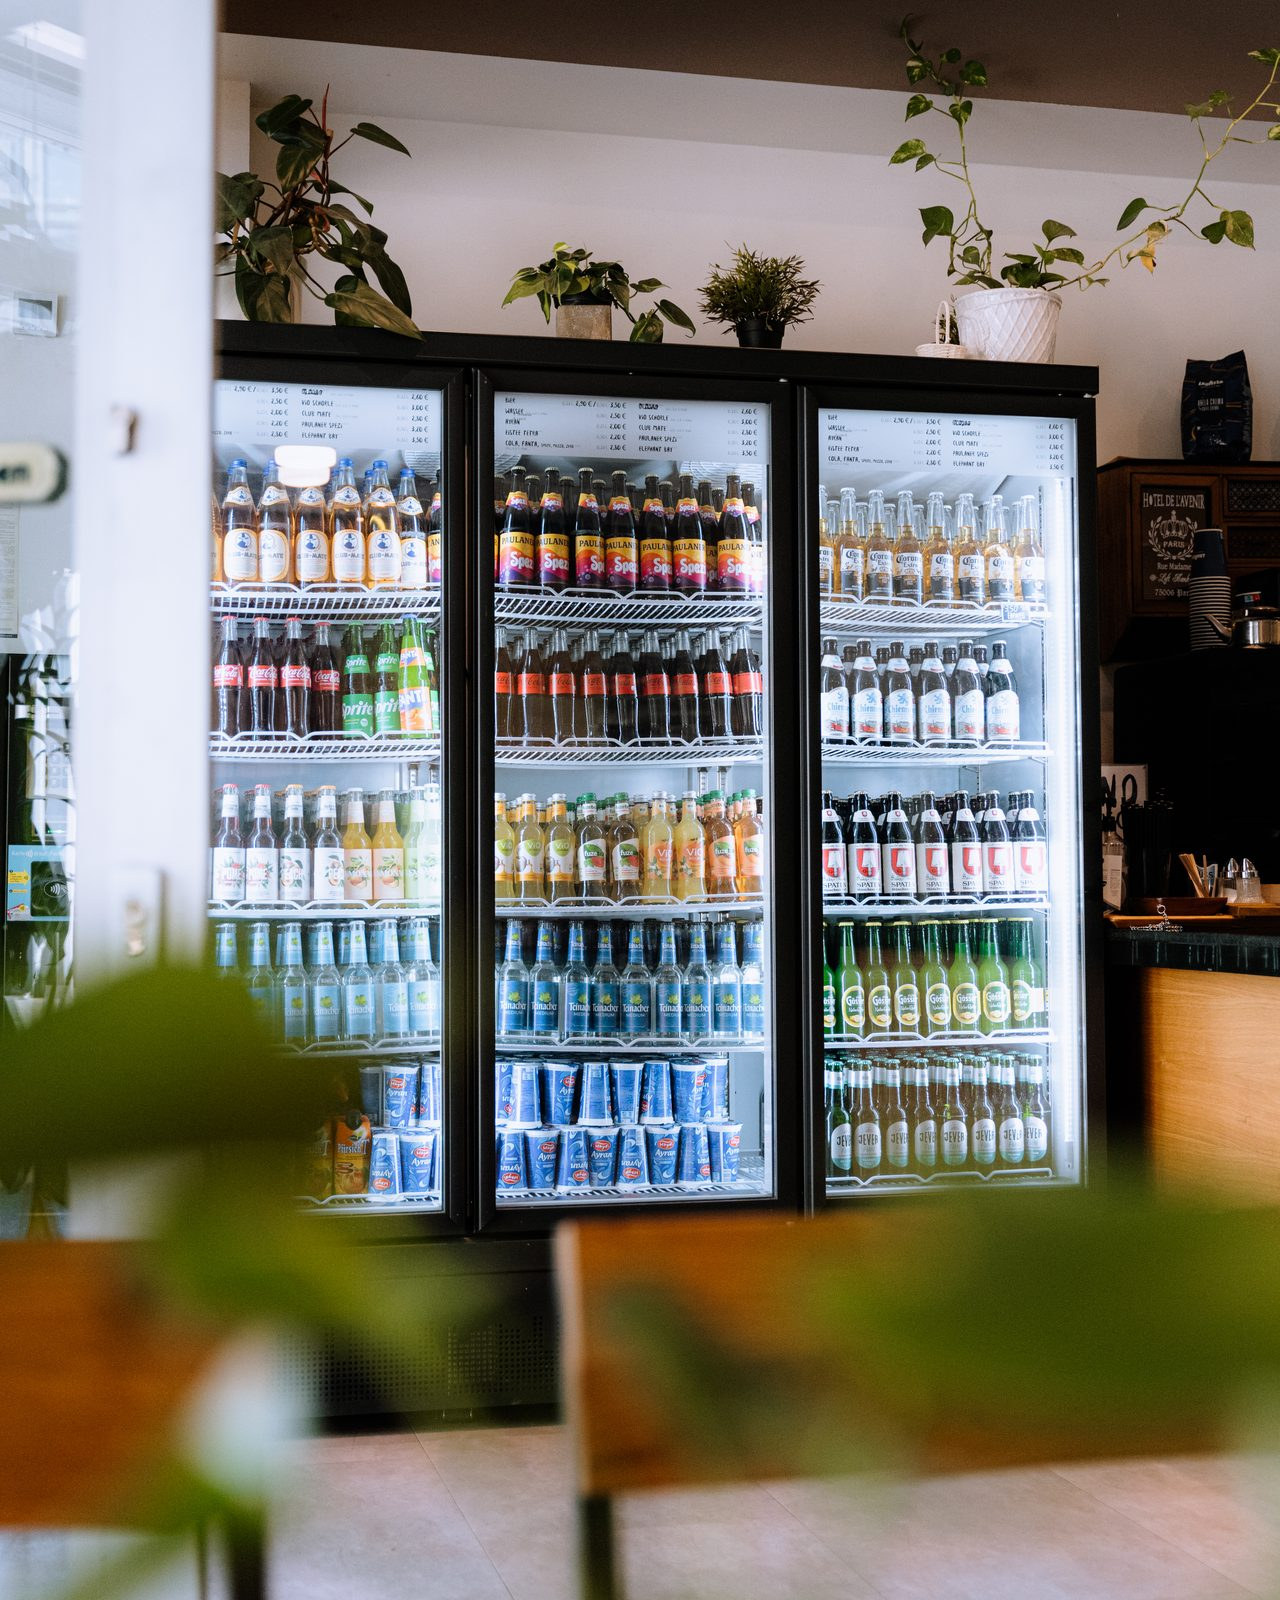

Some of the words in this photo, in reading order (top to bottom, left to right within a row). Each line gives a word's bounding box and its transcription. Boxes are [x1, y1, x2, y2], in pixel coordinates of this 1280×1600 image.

[1143, 492, 1164, 508] HOTEL
[1165, 494, 1175, 507] DE
[1175, 494, 1205, 509] L'AVENIR
[501, 535, 534, 546] PAULANE
[1163, 540, 1185, 548] PARIS
[642, 542, 672, 553] PAULA
[718, 542, 748, 553] PAULAN
[510, 552, 534, 570] Spez
[543, 552, 569, 571] Spez
[870, 553, 890, 562] Coro
[896, 555, 920, 564] Coron
[614, 556, 637, 574] Spe
[654, 557, 672, 576] Spe
[1157, 562, 1168, 570] Rue
[1169, 562, 1192, 570] Madame
[1155, 588, 1175, 596] 75006
[1177, 588, 1190, 597] Par
[376, 699, 401, 716] prit
[620, 849, 633, 857] fuze
[531, 1001, 557, 1011] Teinacher
[569, 1002, 591, 1012] Teinac
[592, 1003, 619, 1013] Teinacher
[622, 1003, 650, 1013] Teinacher
[943, 1131, 965, 1143] JEVER
[1024, 1127, 1042, 1140] EVER
[837, 1134, 851, 1147] JEV
[858, 1134, 879, 1146] JEVER
[590, 1150, 613, 1160] Ayran
[655, 1148, 676, 1158] Ayran
[621, 1160, 642, 1168] Ayran
